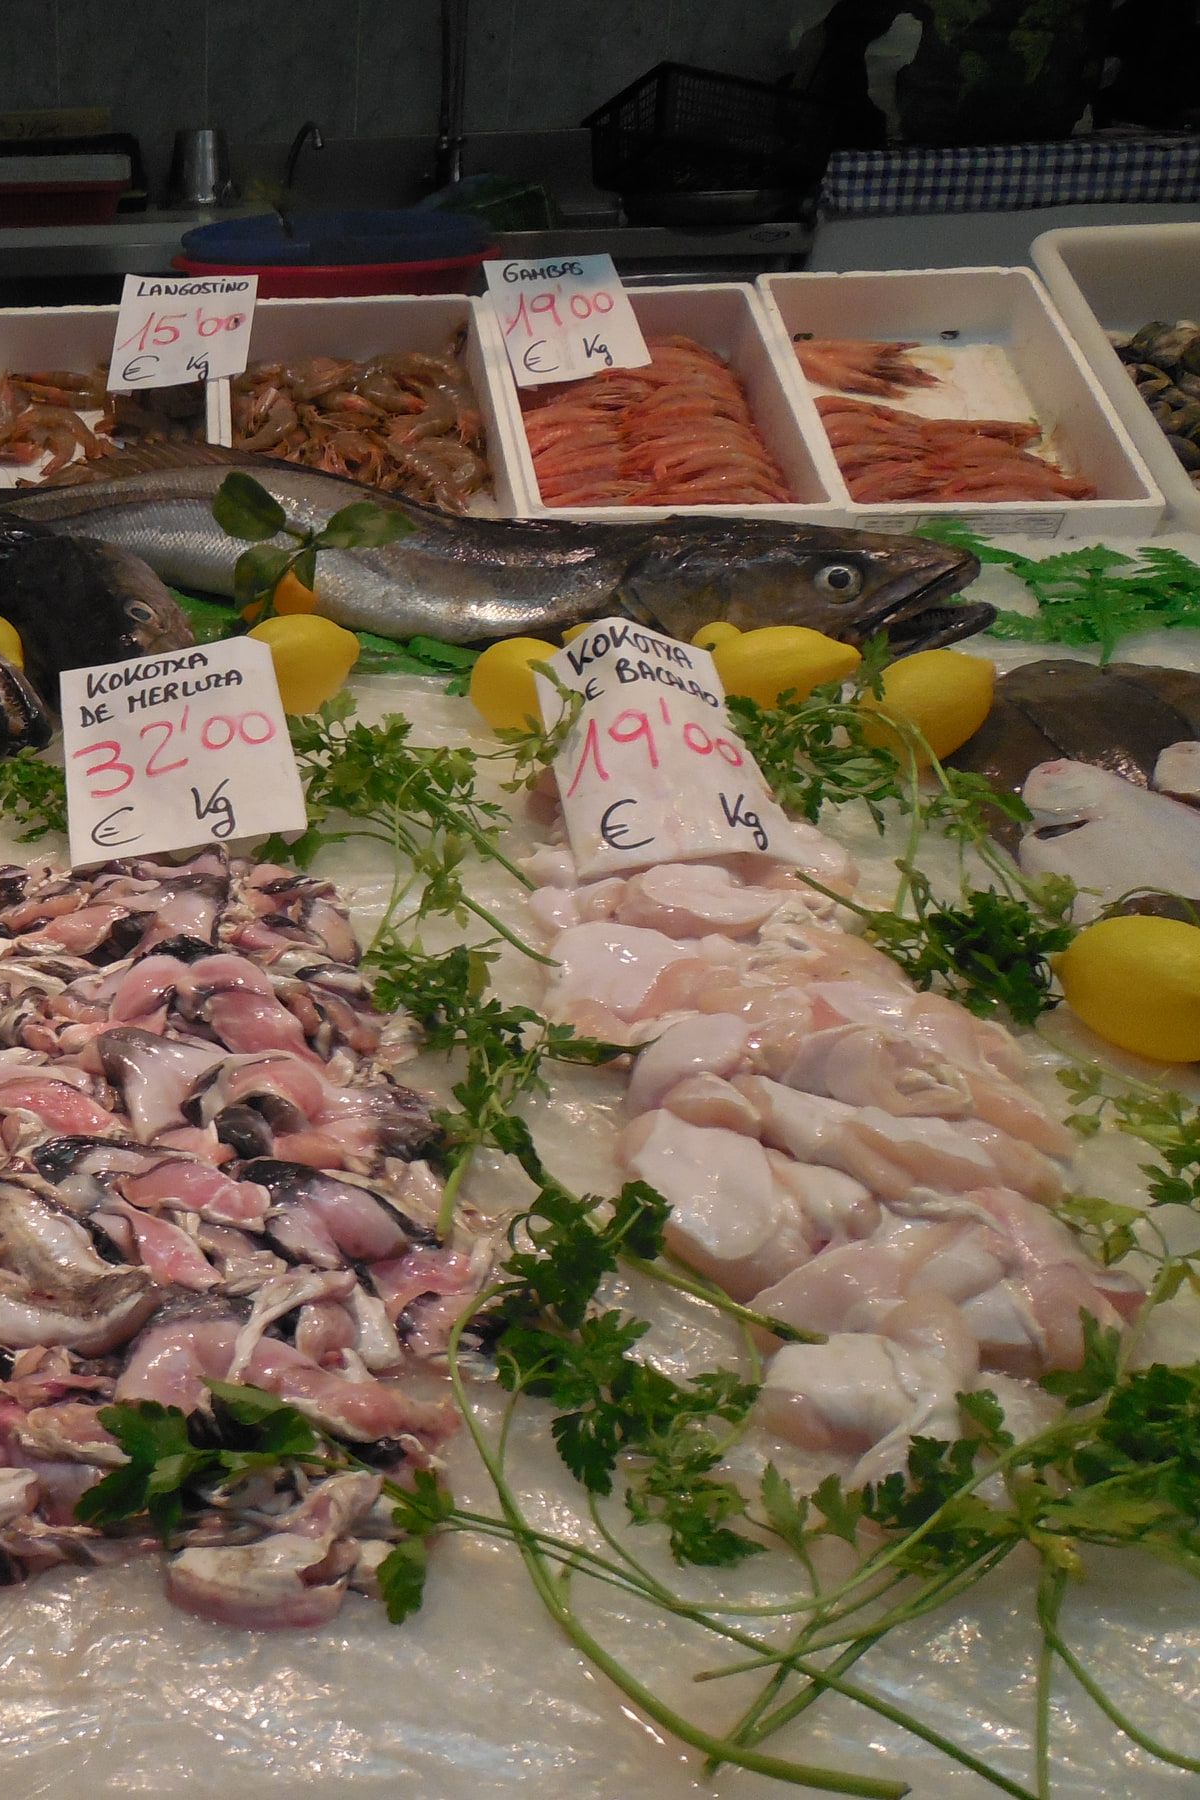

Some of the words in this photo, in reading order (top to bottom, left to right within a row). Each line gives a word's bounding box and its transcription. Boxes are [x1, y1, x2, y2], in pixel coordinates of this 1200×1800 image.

[503, 262, 584, 283] GAMBAS
[506, 284, 614, 336] 19'00
[122, 355, 160, 382] €
[523, 340, 559, 372] €
[86, 652, 209, 699] KOKOTXA
[566, 625, 694, 676] KOKOTXA
[79, 703, 115, 728] DE
[128, 669, 243, 713] MERLUZA
[615, 657, 720, 708] BACALAO
[72, 704, 277, 799] 32'00
[567, 696, 744, 798] 19'00
[91, 806, 144, 847] €
[191, 778, 236, 838] Kg
[600, 798, 656, 850] €
[719, 792, 768, 851] Kg
